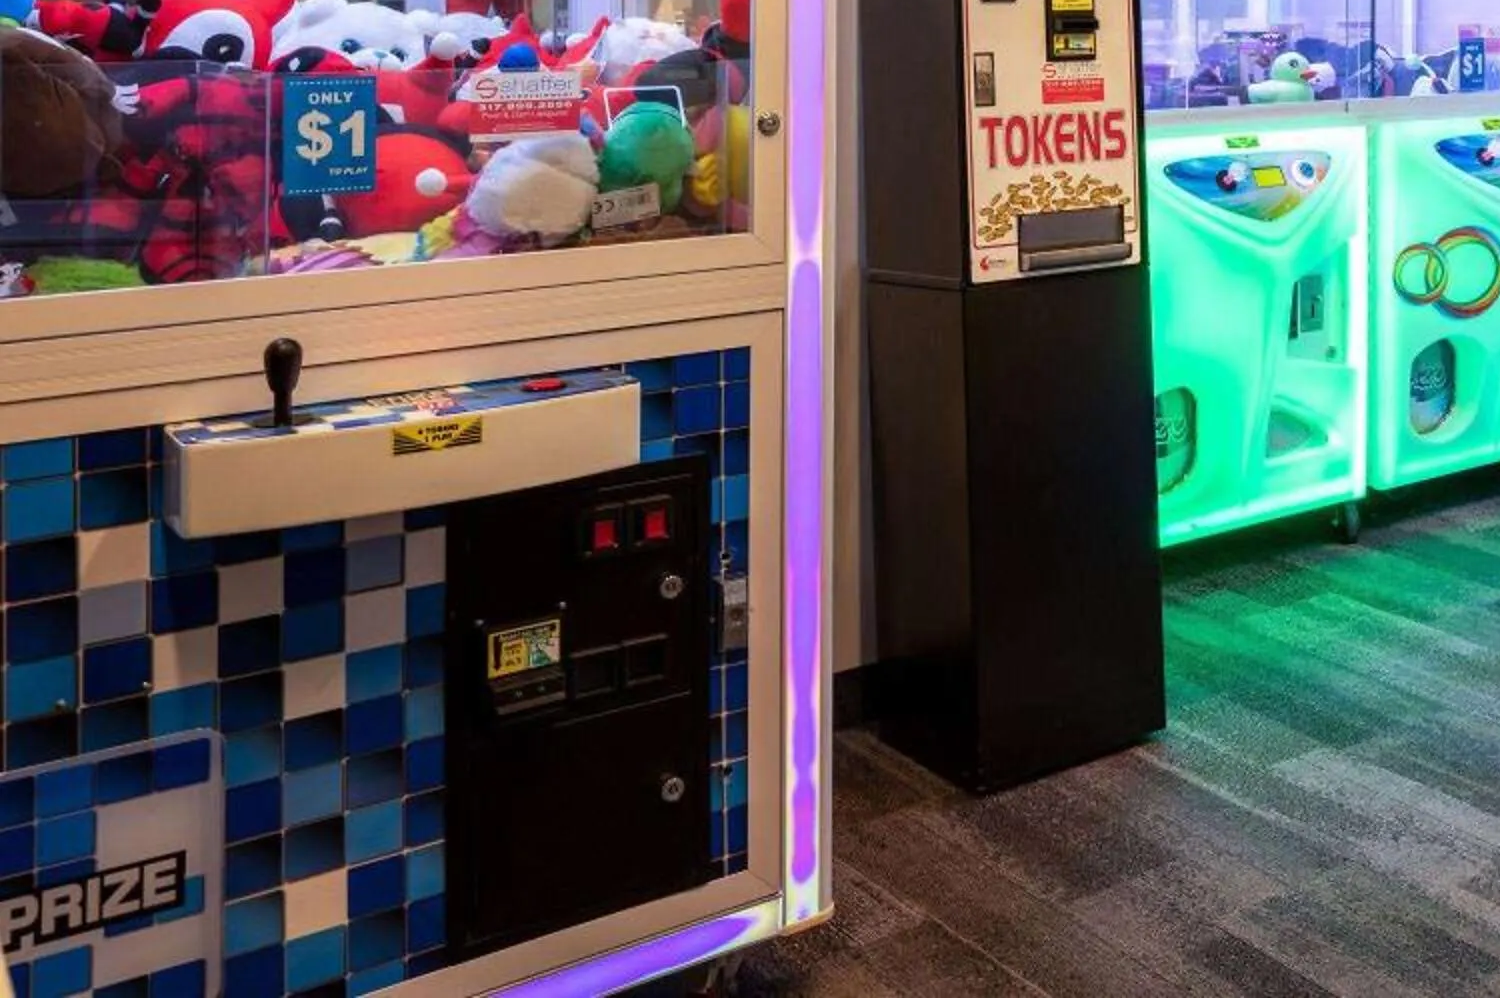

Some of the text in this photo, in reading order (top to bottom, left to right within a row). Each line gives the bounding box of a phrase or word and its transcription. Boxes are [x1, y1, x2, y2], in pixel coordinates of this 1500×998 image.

[1463, 53, 1483, 76] $1
[307, 91, 354, 105] ONLY
[295, 108, 366, 167] $1
[978, 108, 1127, 170] TOKENS
[0, 857, 178, 948] PRIZE
